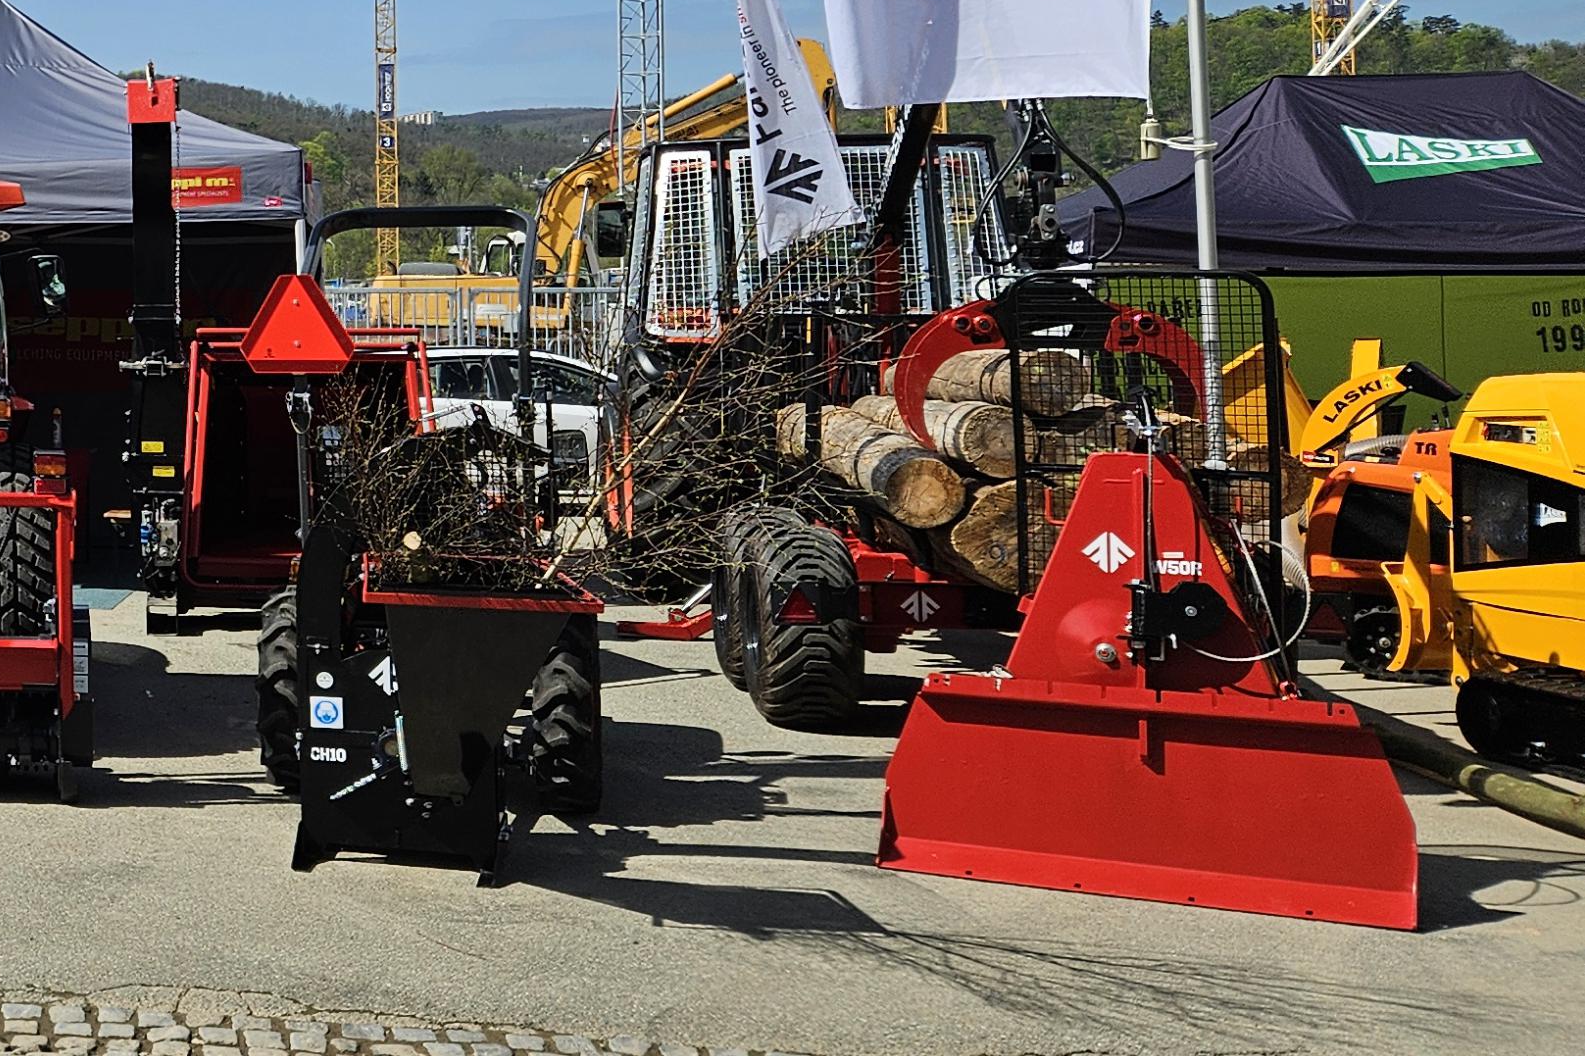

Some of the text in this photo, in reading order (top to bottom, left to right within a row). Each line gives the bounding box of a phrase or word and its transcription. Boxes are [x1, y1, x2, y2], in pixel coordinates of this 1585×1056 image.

[748, 40, 787, 89] pioneer
[778, 88, 798, 116] The
[1350, 128, 1528, 163] LASKI
[1531, 298, 1585, 318] OD RO
[1323, 379, 1383, 424] LASKI
[1415, 442, 1437, 455] TR
[309, 747, 347, 763] CH10
